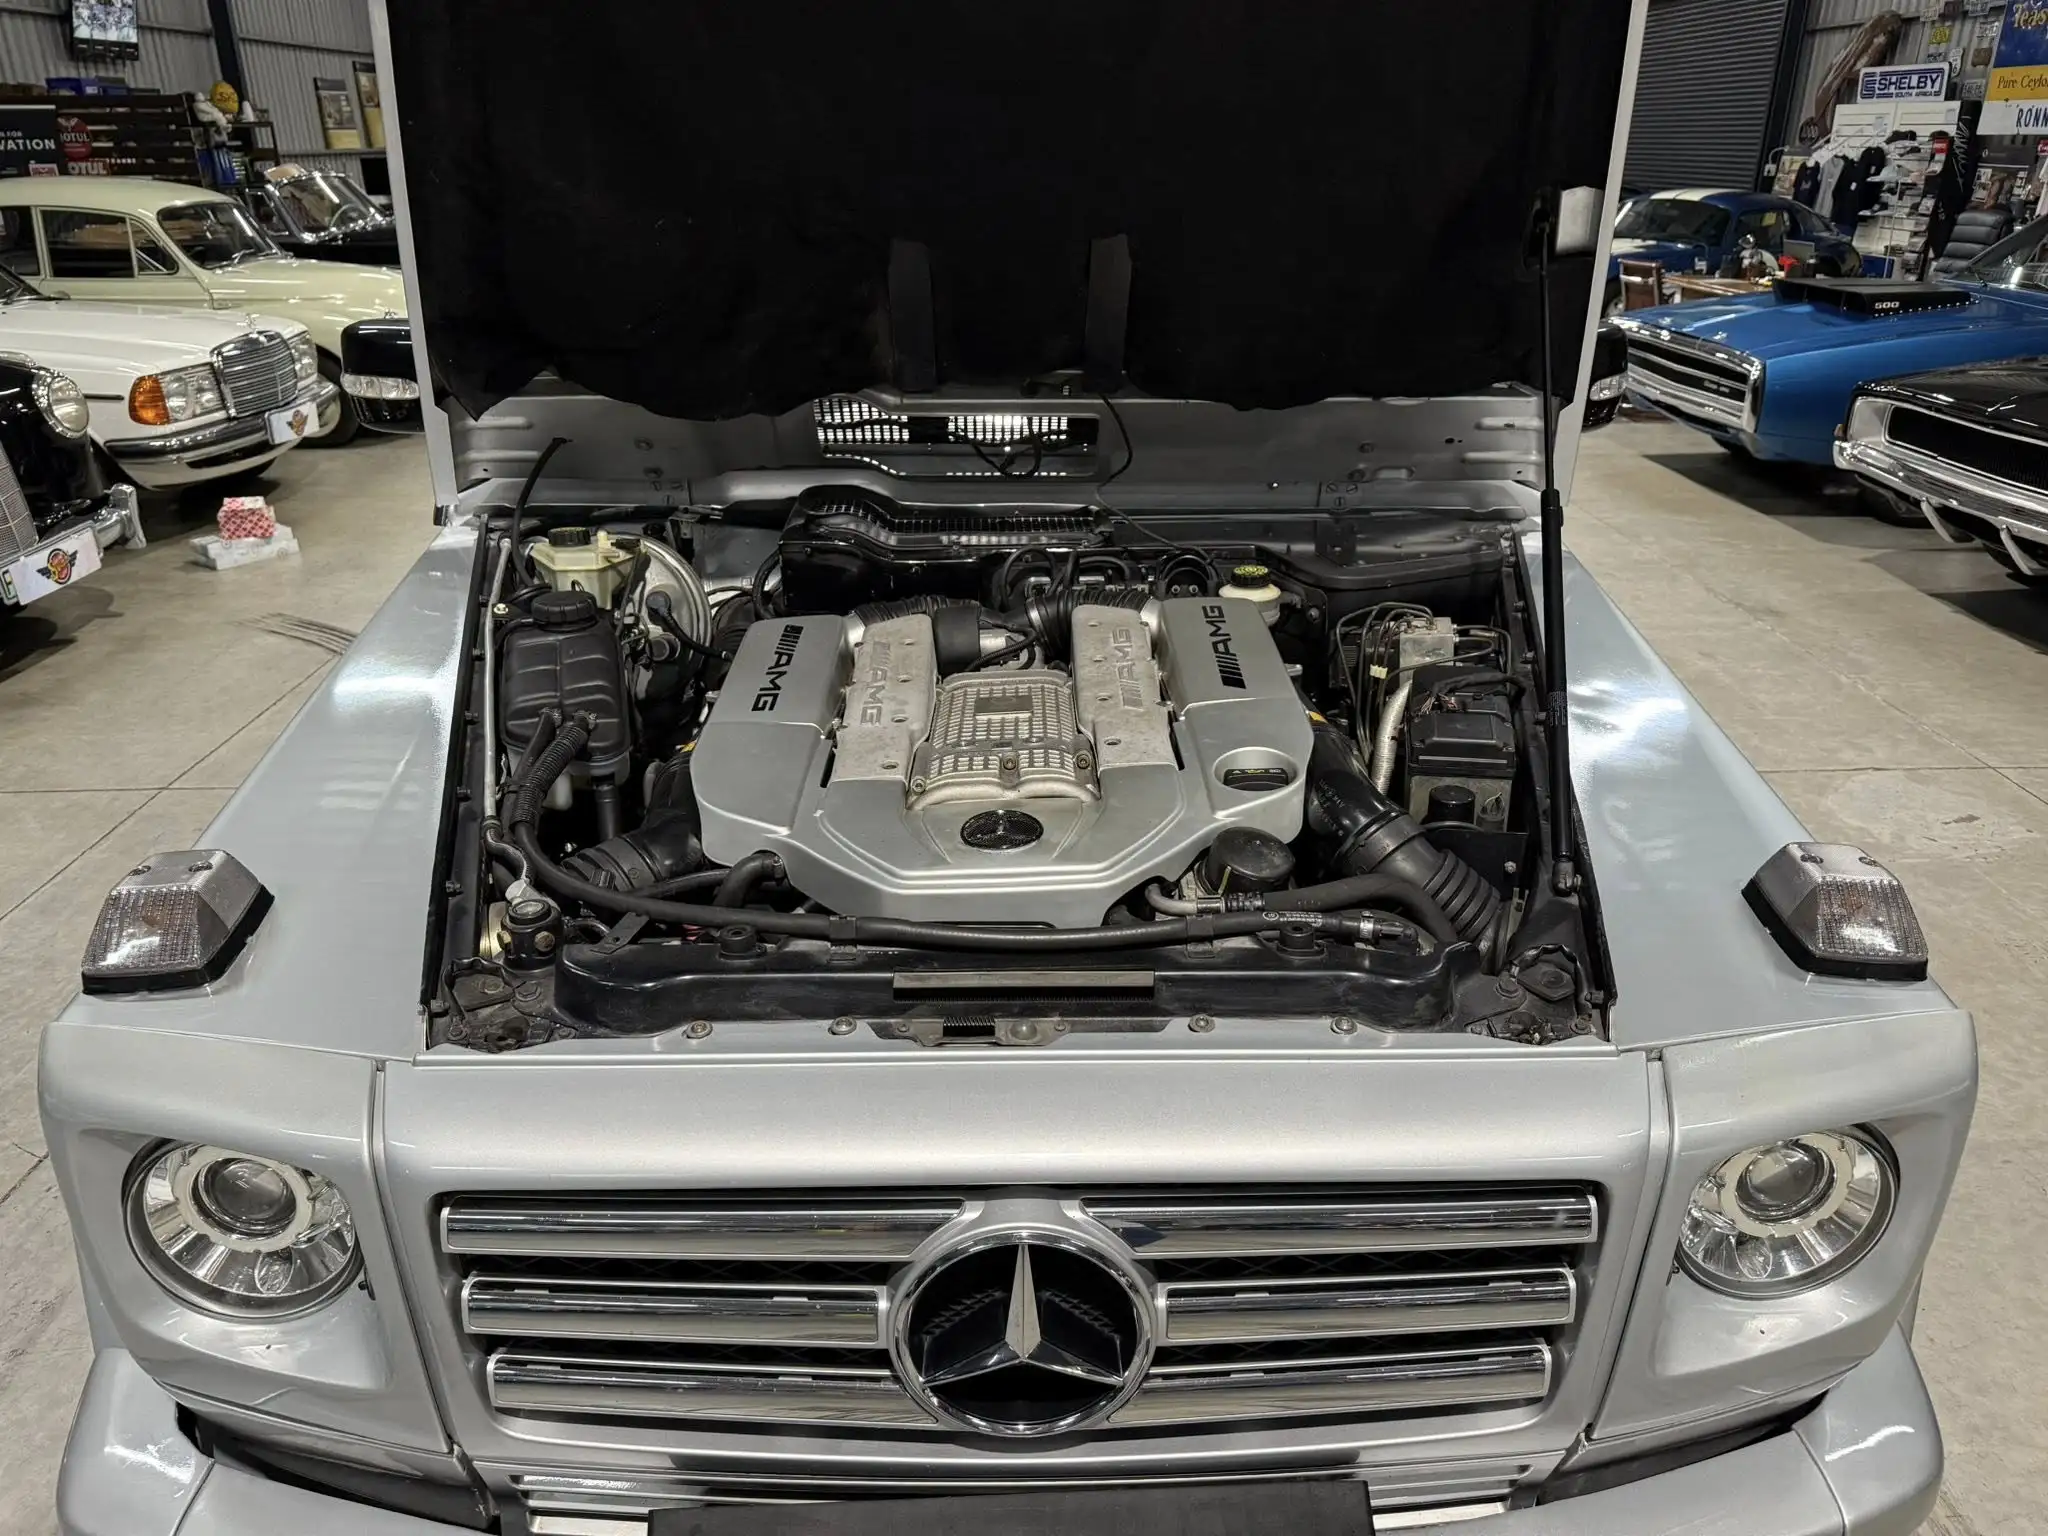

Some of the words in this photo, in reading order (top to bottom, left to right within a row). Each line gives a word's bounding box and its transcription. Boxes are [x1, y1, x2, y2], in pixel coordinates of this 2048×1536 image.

[1877, 74, 1941, 91] SHELBY
[1997, 75, 2017, 89] Pure
[2020, 73, 2048, 91] Ceylo
[60, 131, 90, 144] OTUL
[67, 161, 107, 175] OTUL
[1874, 301, 1900, 309] 500
[1201, 604, 1236, 655] AMG
[1112, 628, 1136, 680] AMG
[751, 652, 795, 712] AMG
[860, 666, 888, 726] AMG
